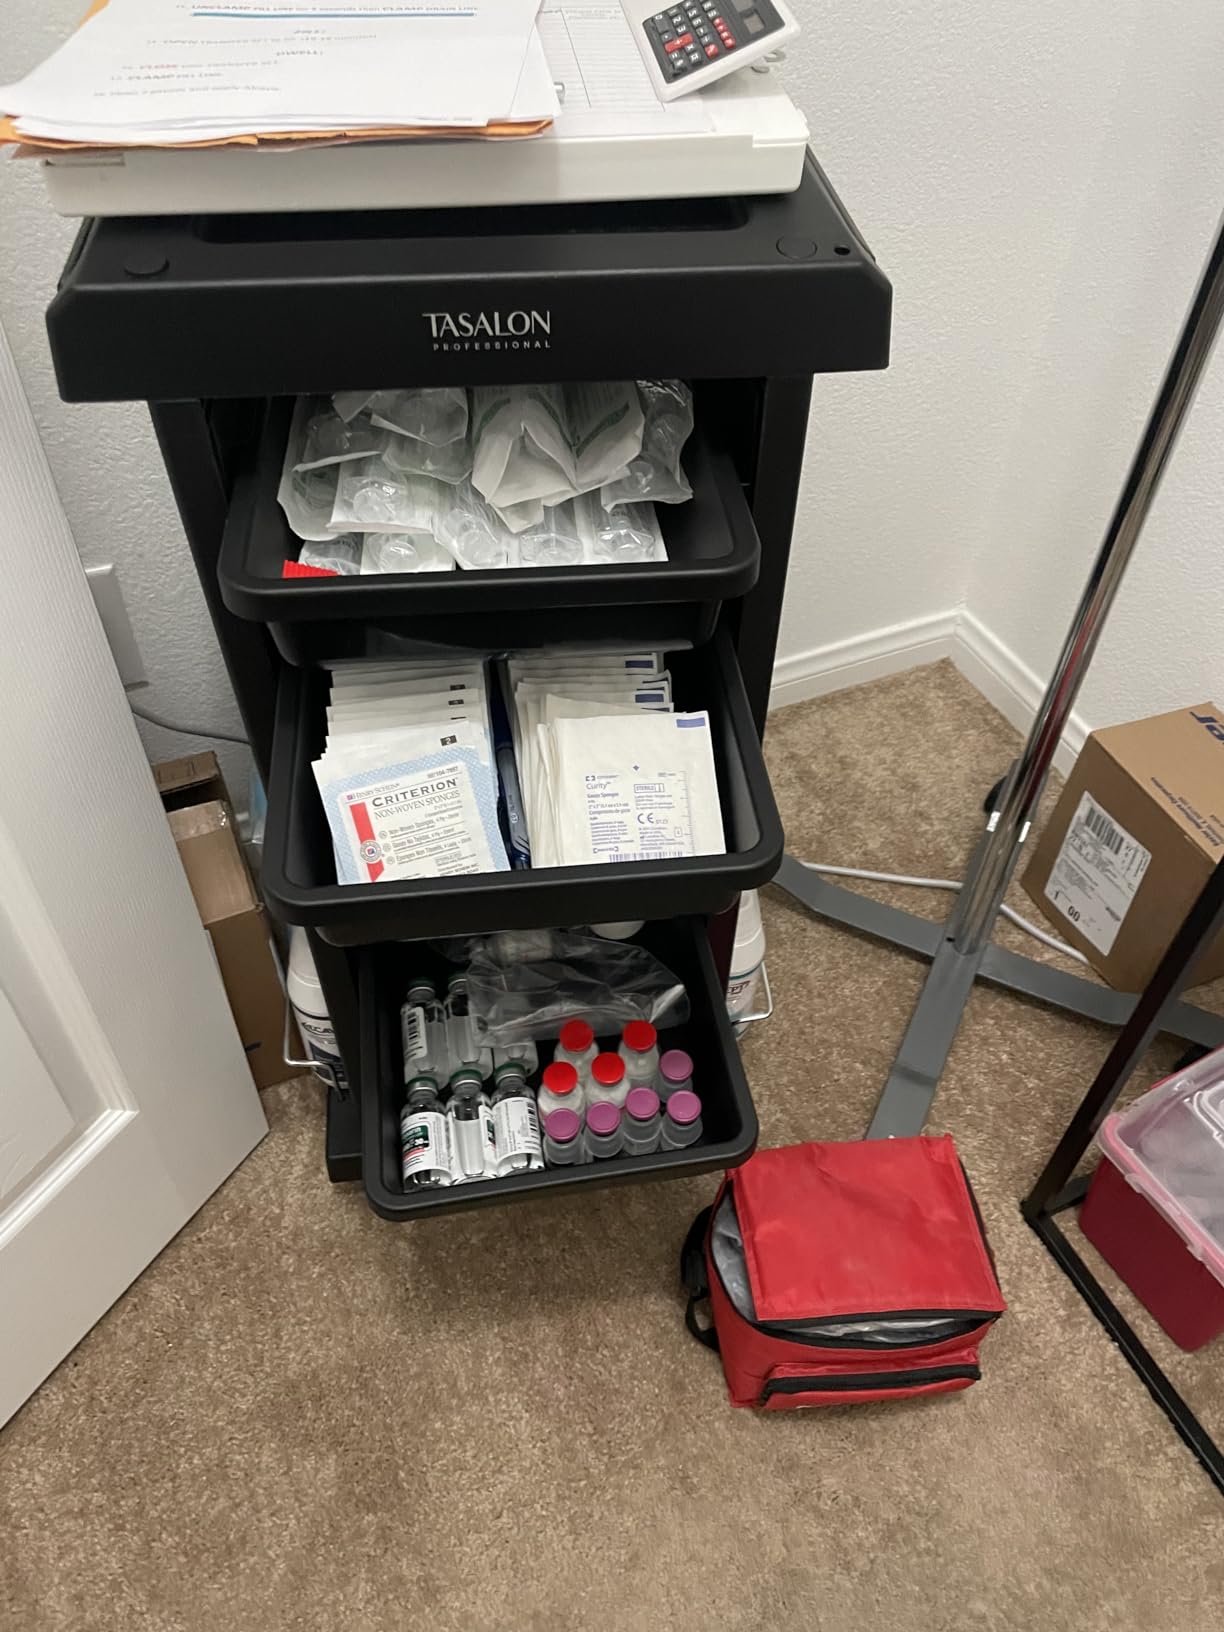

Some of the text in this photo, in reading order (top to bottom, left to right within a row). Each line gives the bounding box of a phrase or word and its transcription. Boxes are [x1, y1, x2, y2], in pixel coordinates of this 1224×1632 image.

[421, 309, 551, 338] TASALON
[432, 339, 552, 352] PROFESSIONAL
[371, 777, 458, 808] CRITERION
